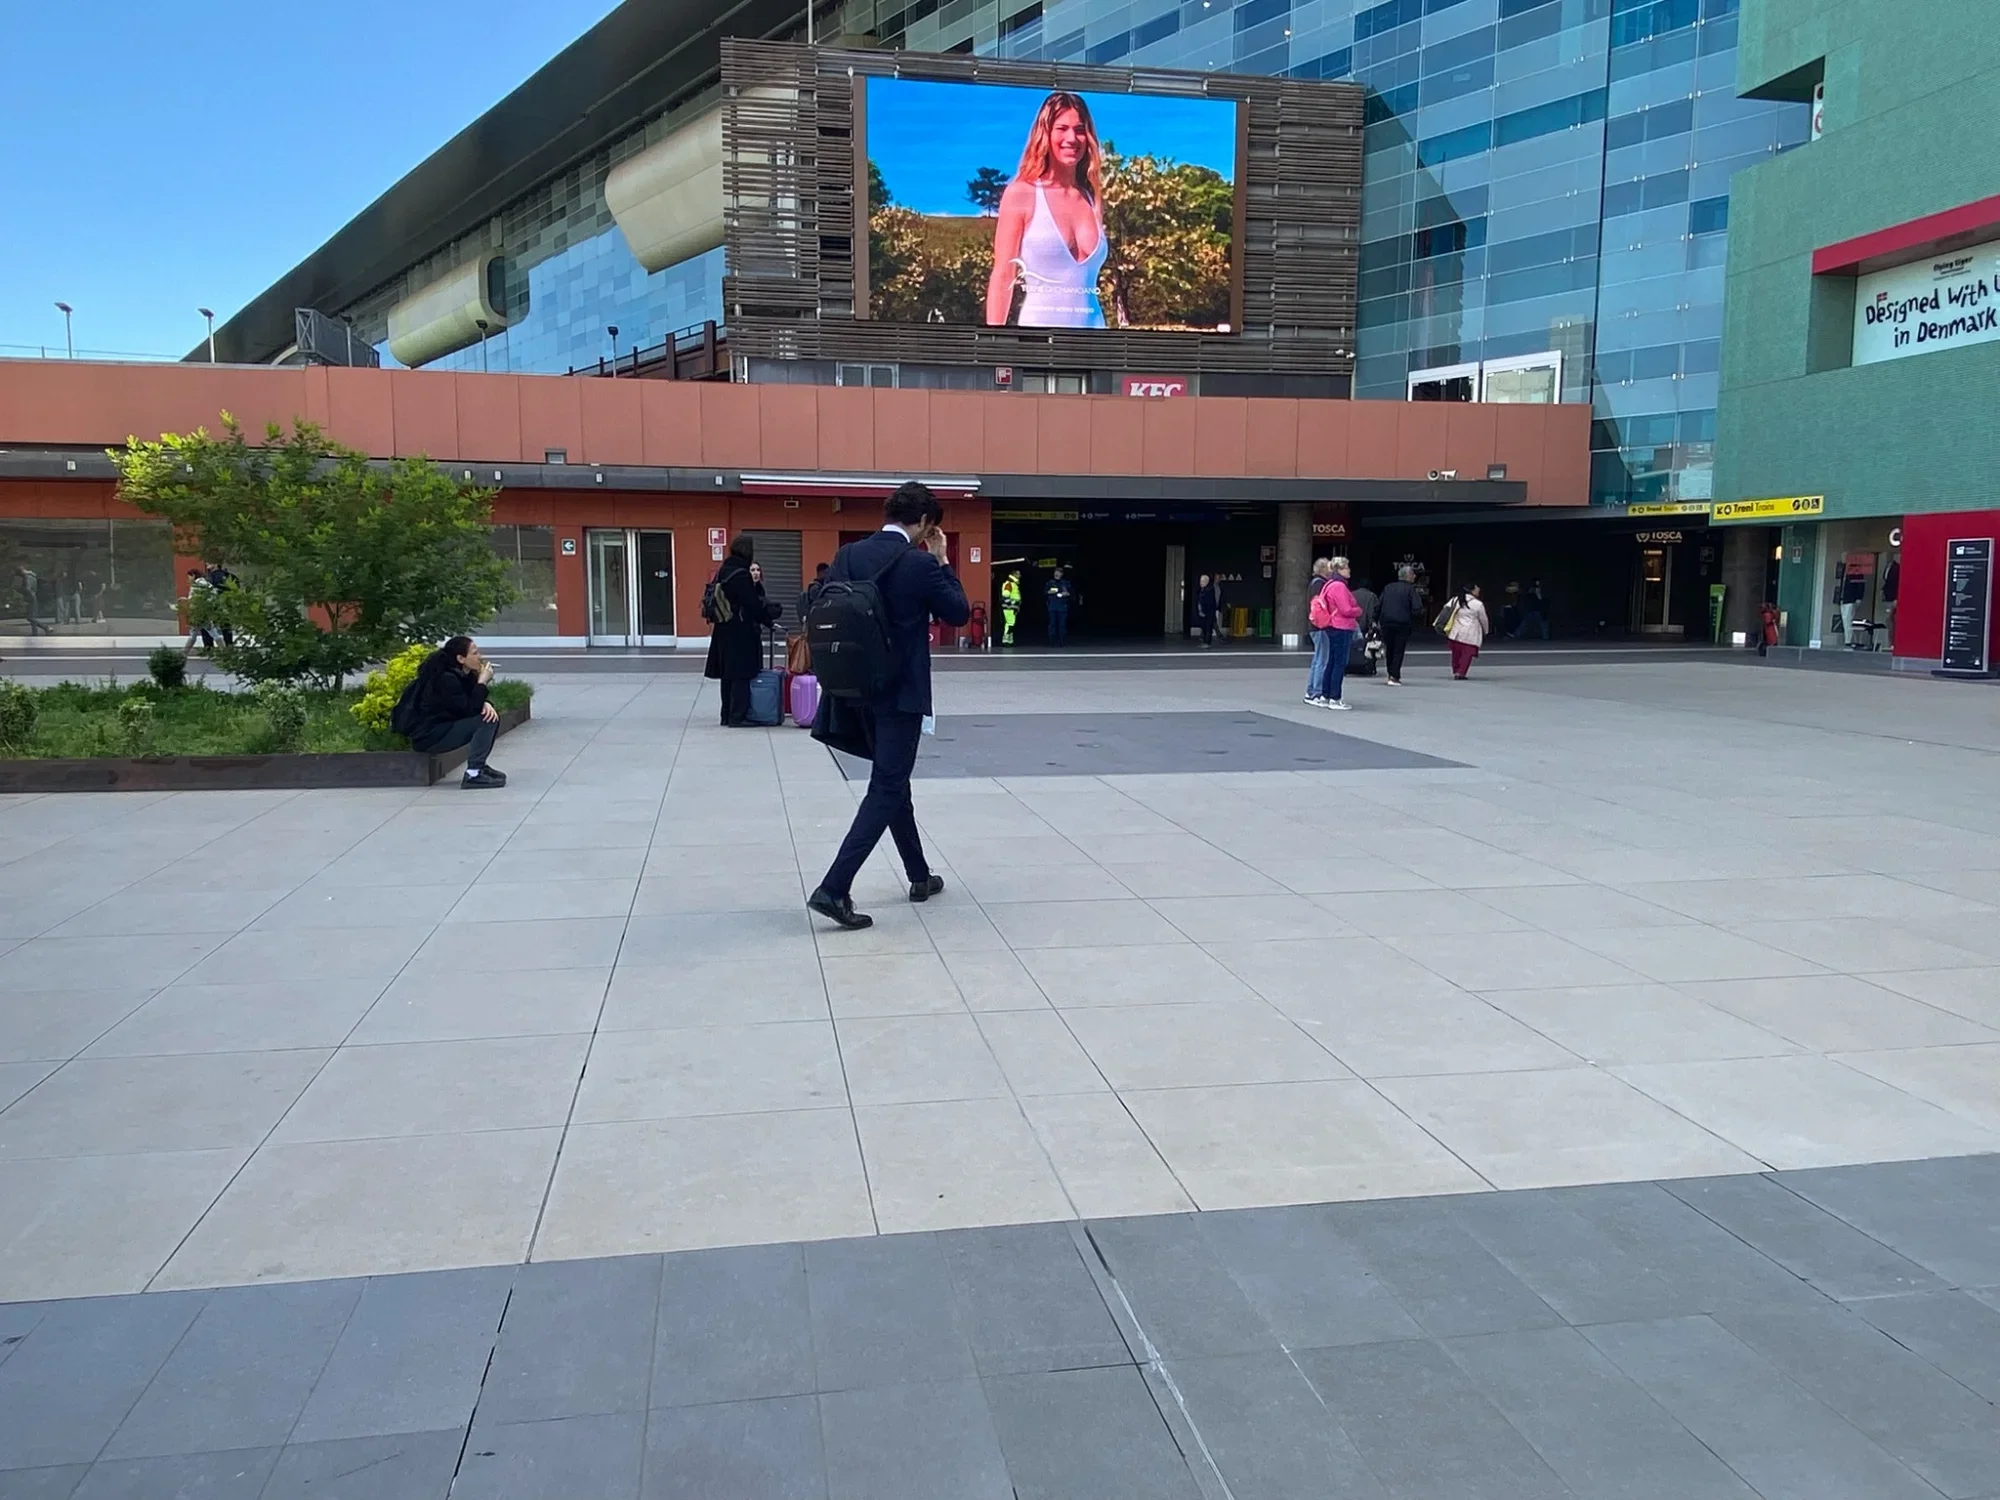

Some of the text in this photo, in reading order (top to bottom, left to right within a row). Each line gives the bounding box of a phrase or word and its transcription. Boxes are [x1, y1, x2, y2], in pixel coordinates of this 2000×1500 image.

[1866, 288, 1940, 325] Designed
[1894, 306, 1998, 348] in Denmark
[1130, 383, 1182, 397] KFC
[1312, 524, 1346, 533] TOSCA
